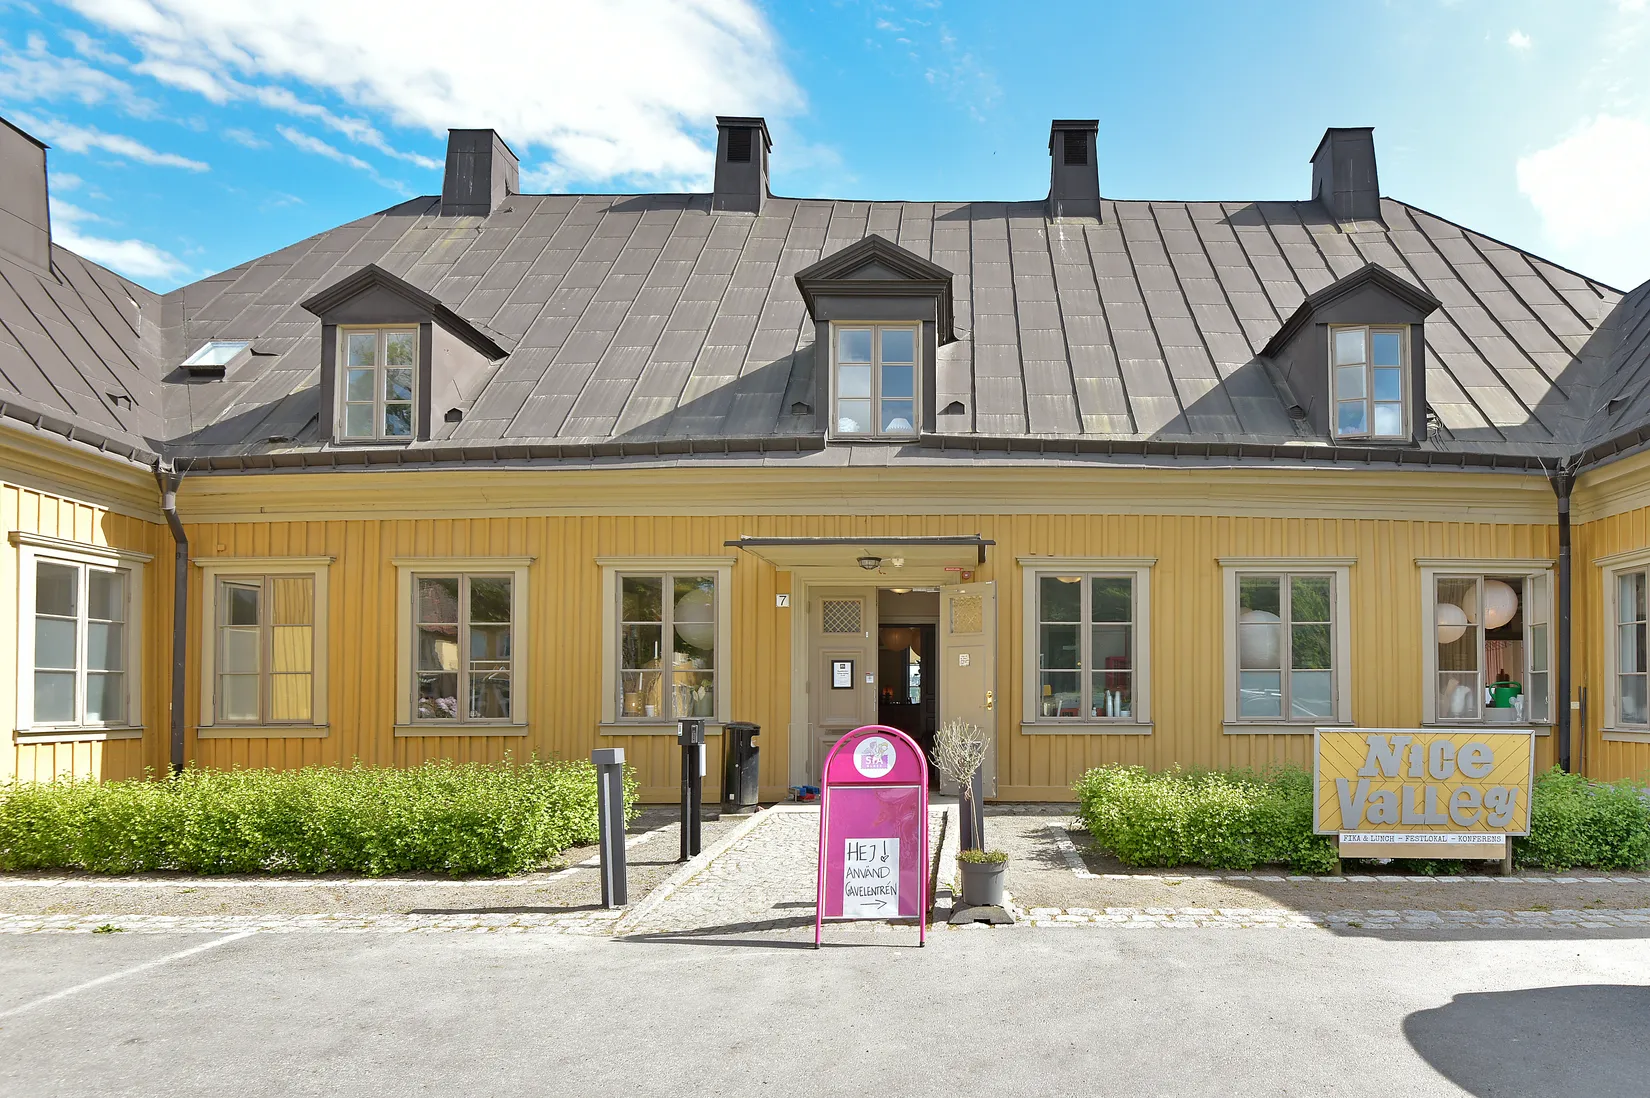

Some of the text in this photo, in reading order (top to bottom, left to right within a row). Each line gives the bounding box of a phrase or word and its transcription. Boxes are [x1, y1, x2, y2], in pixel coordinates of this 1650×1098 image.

[778, 595, 787, 606] 7
[1458, 835, 1502, 843] KONFERENS
[846, 866, 890, 879] ANVÄND
[845, 881, 897, 896] GAVELENTRÉN
